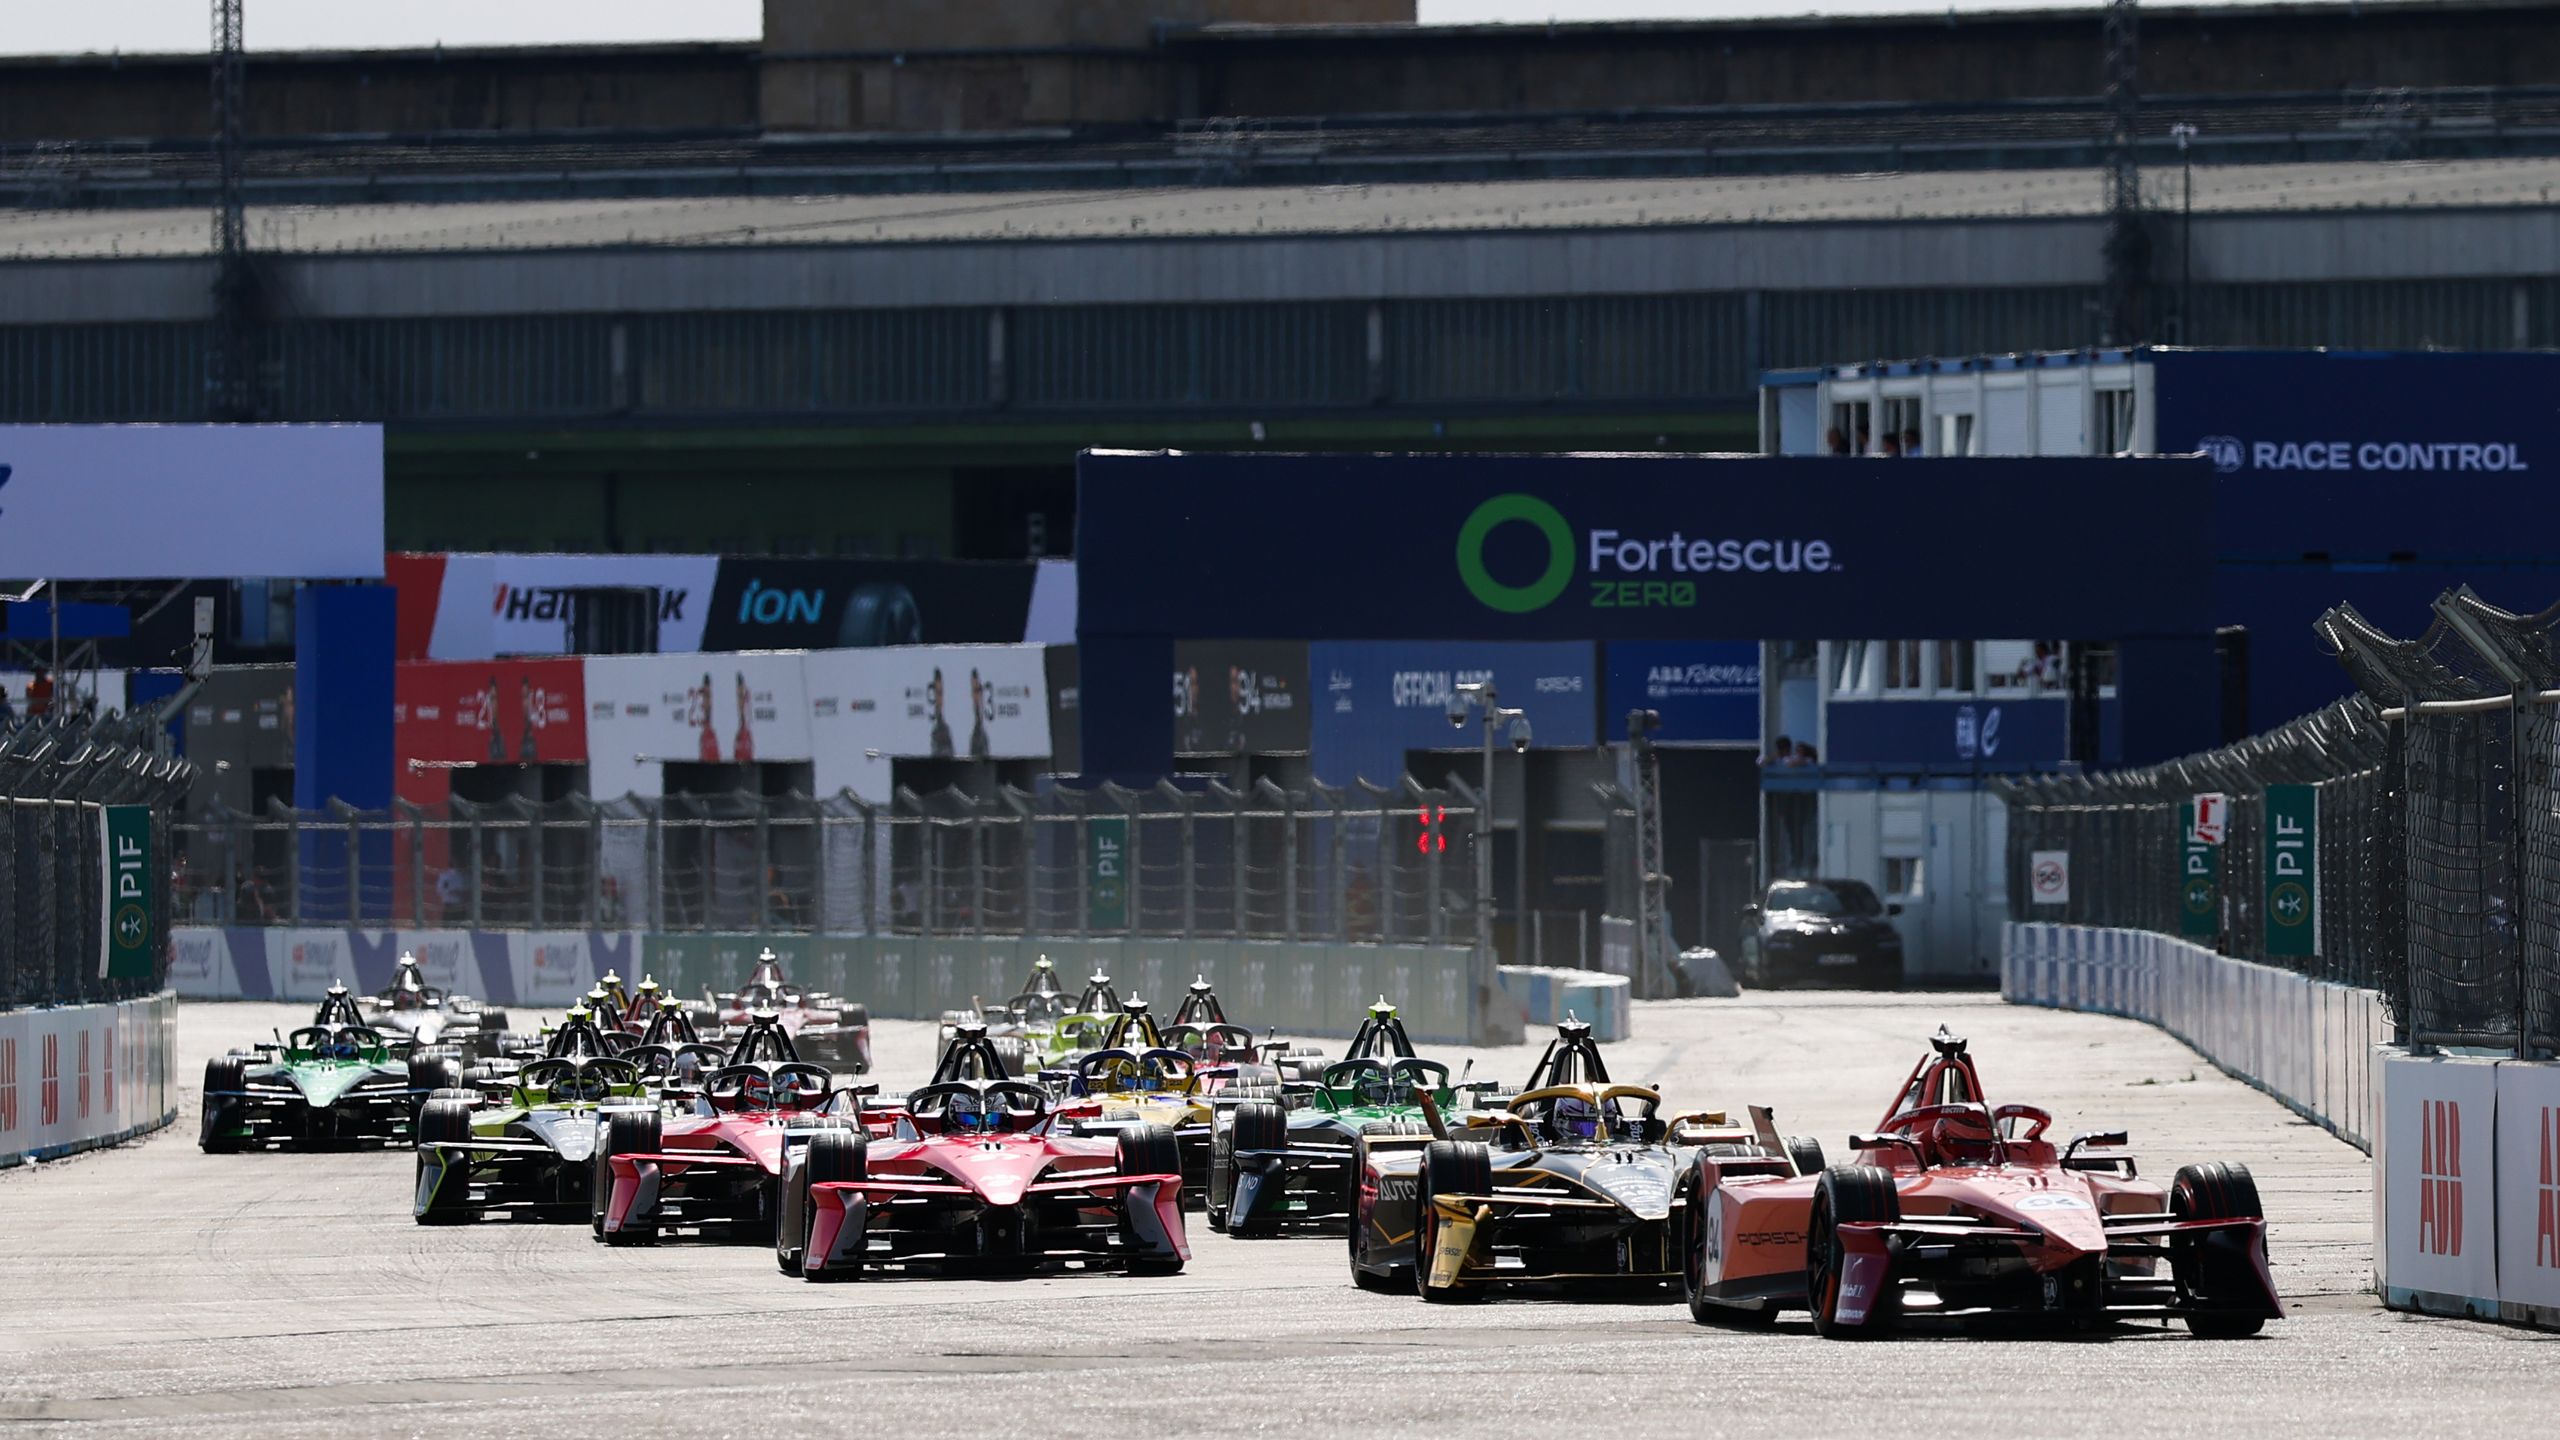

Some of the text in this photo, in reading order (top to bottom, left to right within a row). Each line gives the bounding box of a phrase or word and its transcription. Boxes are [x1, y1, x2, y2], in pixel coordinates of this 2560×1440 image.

[2253, 442, 2351, 470] RACE
[2358, 442, 2528, 471] CONTROL
[1238, 670, 1261, 714] 94
[118, 834, 142, 899] PIF
[1098, 835, 1119, 877] PIF
[2276, 813, 2304, 876] PIF
[41, 1033, 59, 1127] ABB
[1379, 1180, 1418, 1201] AUTO
[2419, 1099, 2464, 1257] ABB
[1708, 1216, 1720, 1263] 94
[1738, 1231, 1808, 1246] PORSCH
